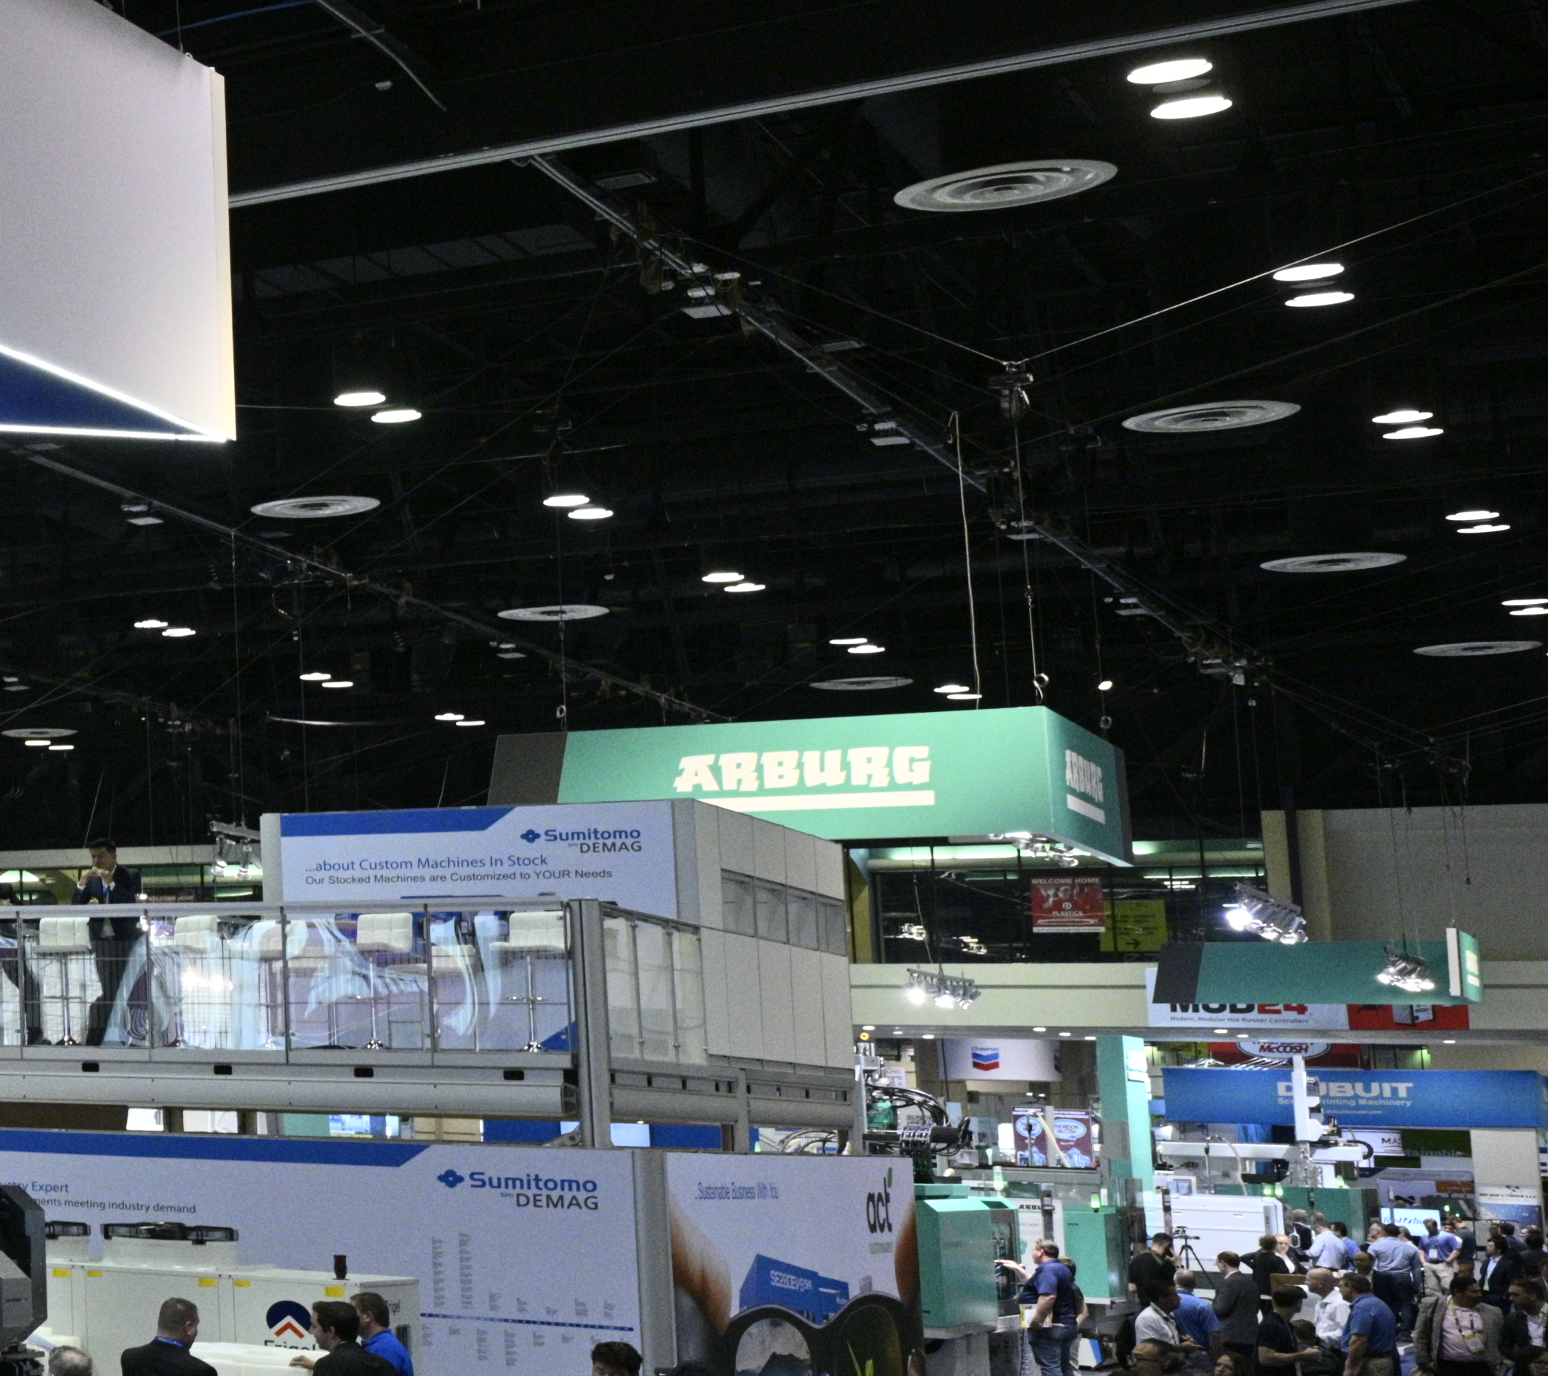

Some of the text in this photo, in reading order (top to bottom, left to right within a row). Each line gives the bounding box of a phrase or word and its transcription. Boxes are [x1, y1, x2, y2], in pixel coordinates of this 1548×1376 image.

[673, 745, 933, 793] ARBURG
[544, 828, 641, 842] Sumitomo
[579, 841, 642, 854] DEMAG
[359, 858, 413, 871] Custom
[417, 856, 486, 870] Machines
[490, 856, 503, 867] In
[507, 854, 548, 867] Stock
[306, 869, 613, 885] Our Stocked Machines are Customized to YOUR Needs
[1359, 1098, 1413, 1108] Machinery
[32, 1181, 69, 1194] Expert
[469, 1171, 598, 1193] Sumitomo
[731, 1182, 756, 1200] Business
[64, 1199, 196, 1214] meeting industry demand
[515, 1190, 599, 1212] DEMAG
[866, 1177, 893, 1234] act
